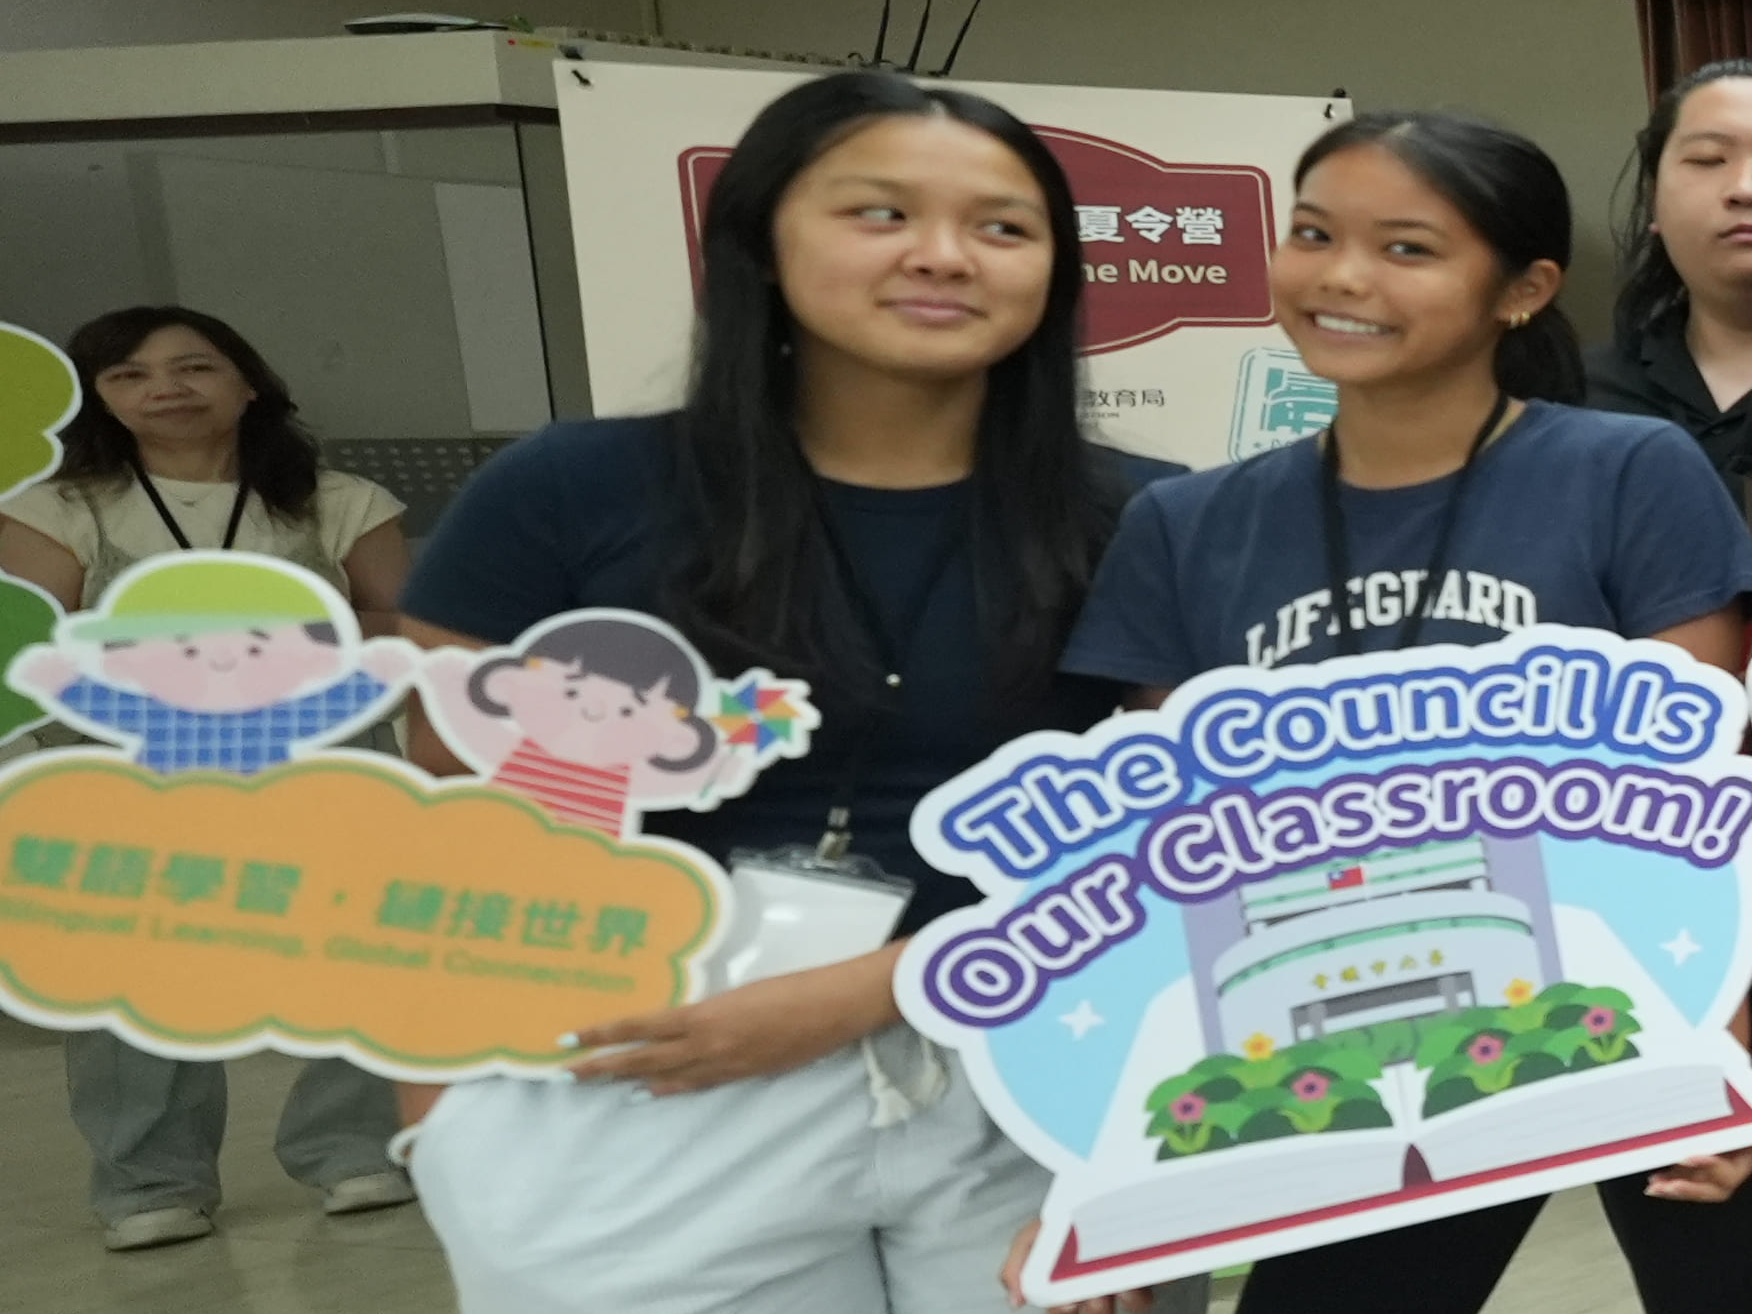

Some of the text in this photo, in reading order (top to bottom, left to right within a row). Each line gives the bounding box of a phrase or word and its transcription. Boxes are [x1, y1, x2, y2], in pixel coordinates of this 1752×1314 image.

[1075, 205, 1225, 246] 夏令營
[1129, 258, 1228, 285] Move
[944, 651, 1720, 878] The Council Is
[925, 860, 1144, 1026] Our
